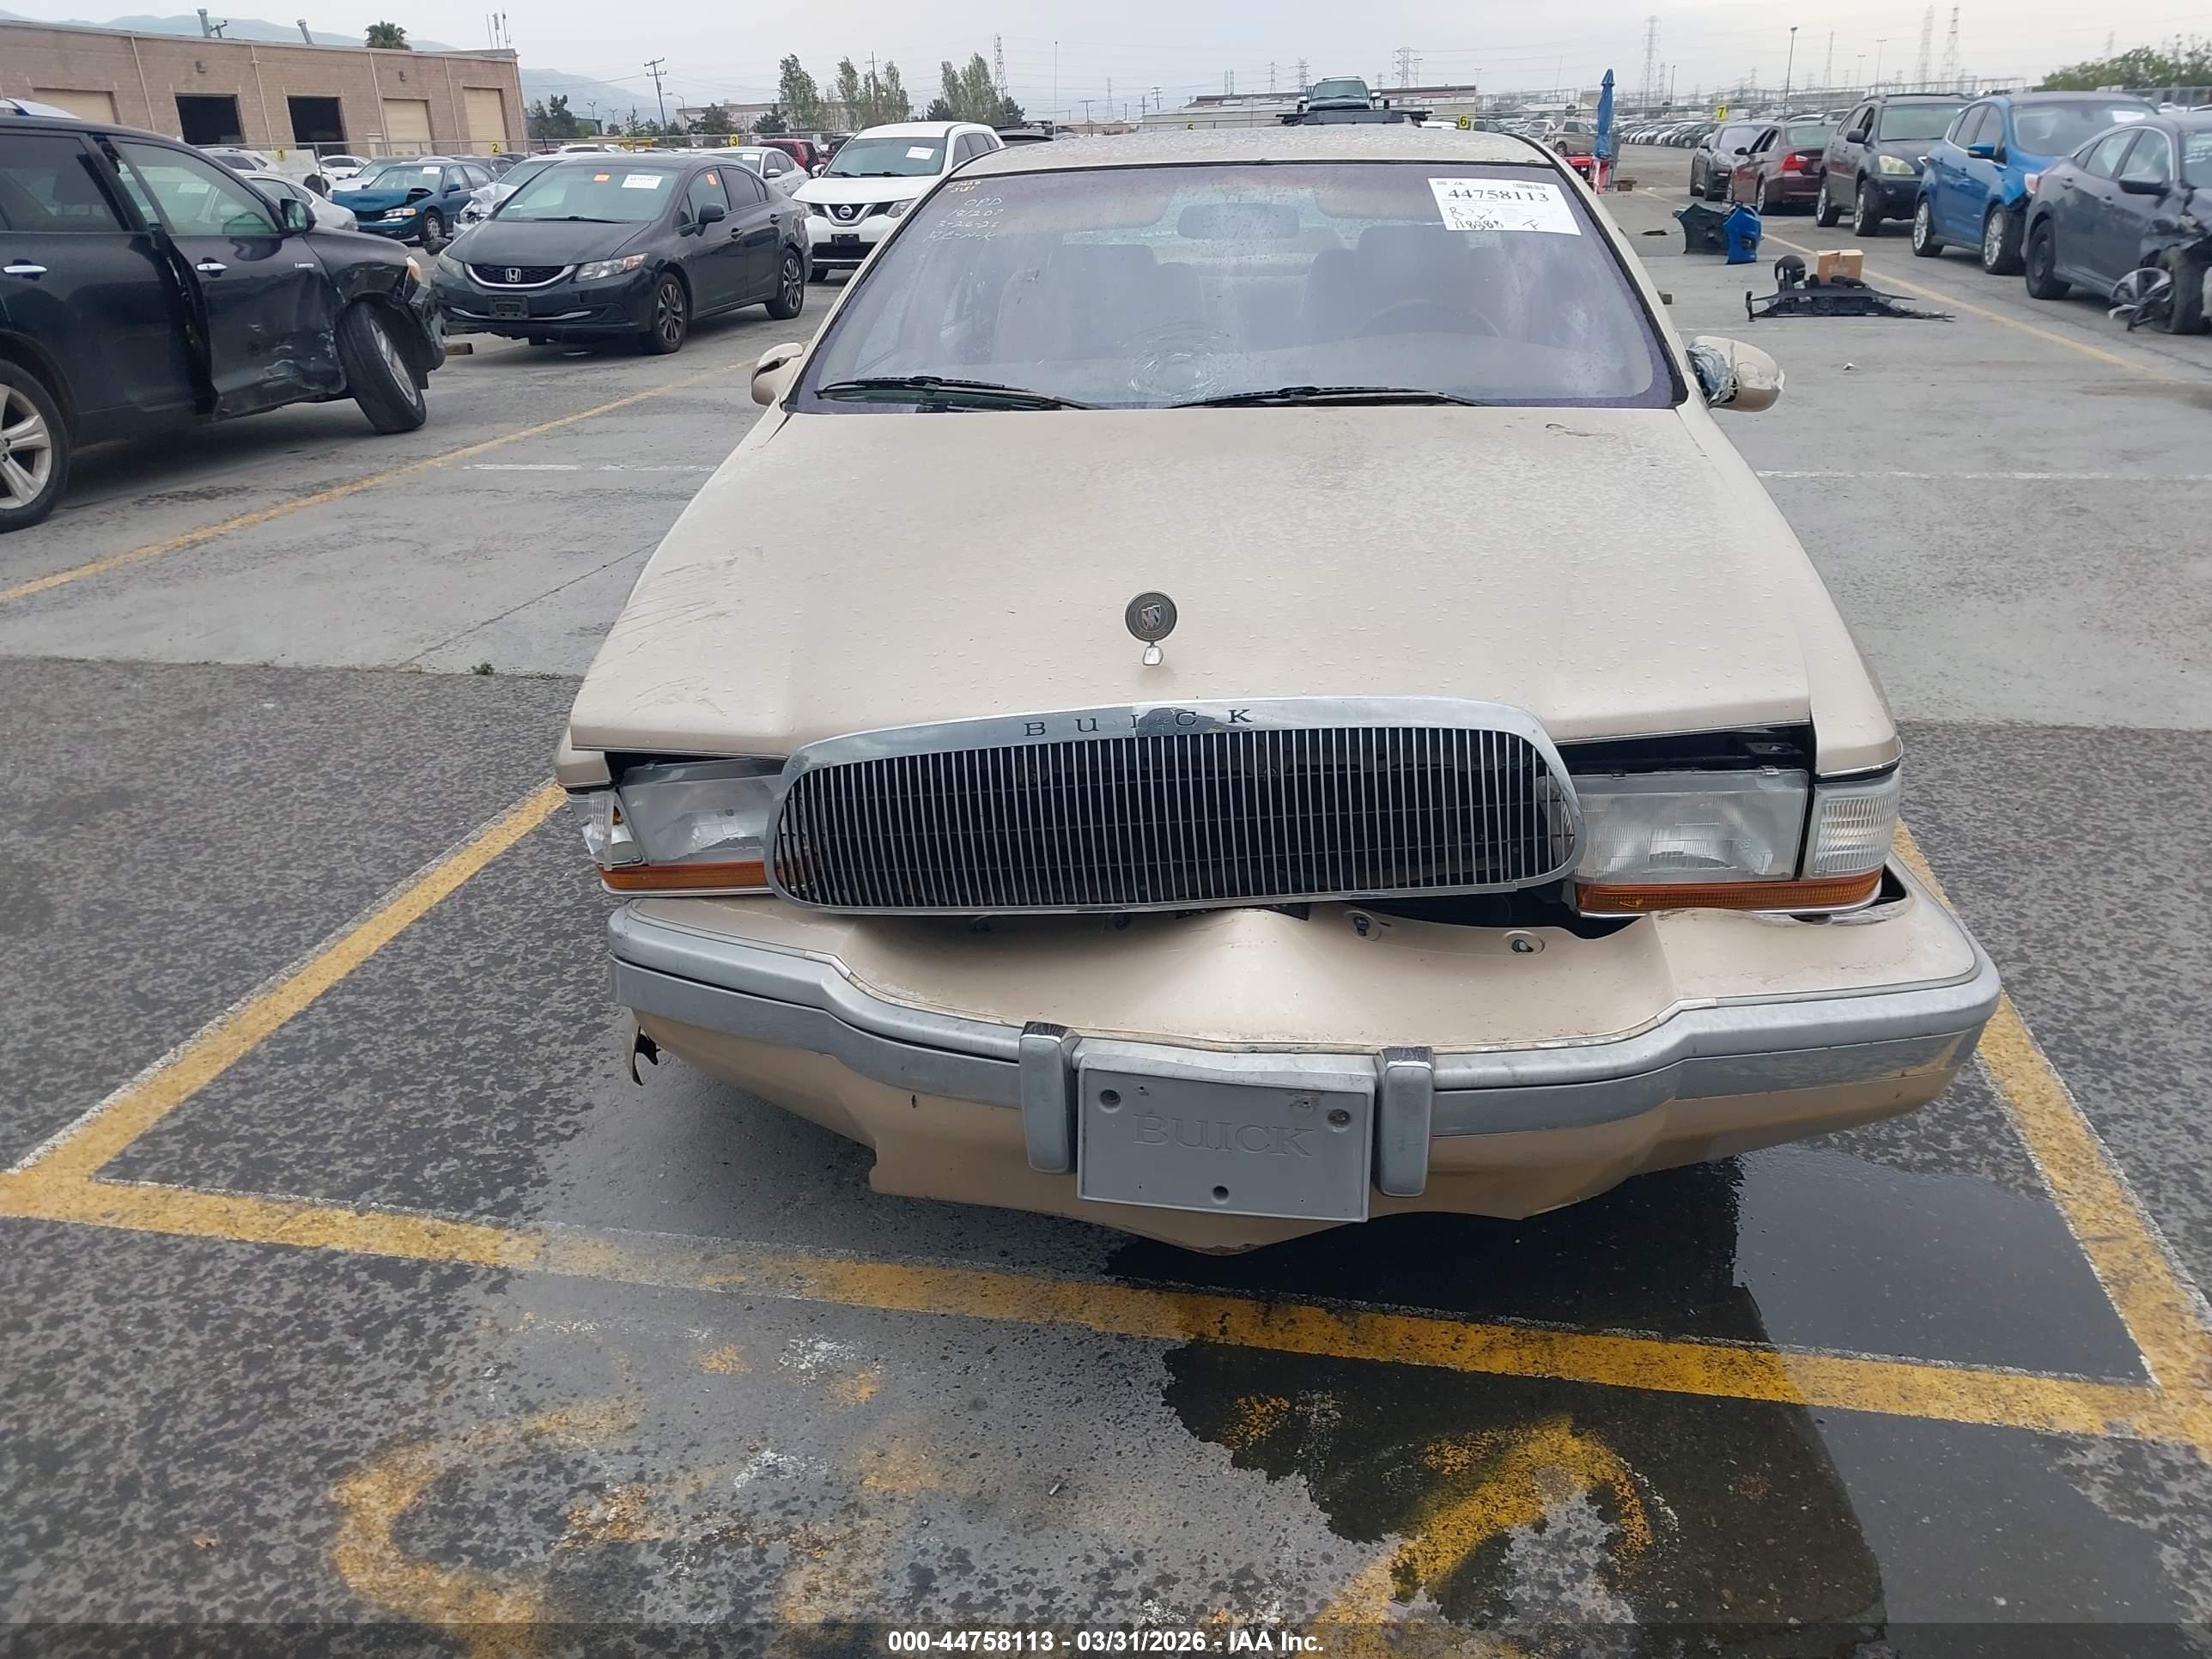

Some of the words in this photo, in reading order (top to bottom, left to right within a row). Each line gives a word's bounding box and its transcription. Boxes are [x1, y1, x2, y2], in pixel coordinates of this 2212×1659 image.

[1717, 106, 1724, 118] 7
[1460, 116, 1467, 126] 6
[732, 136, 738, 146] 3
[1448, 189, 1549, 203] 44758113
[1023, 708, 1254, 737] BUICK
[1133, 1113, 1314, 1158] BUICK
